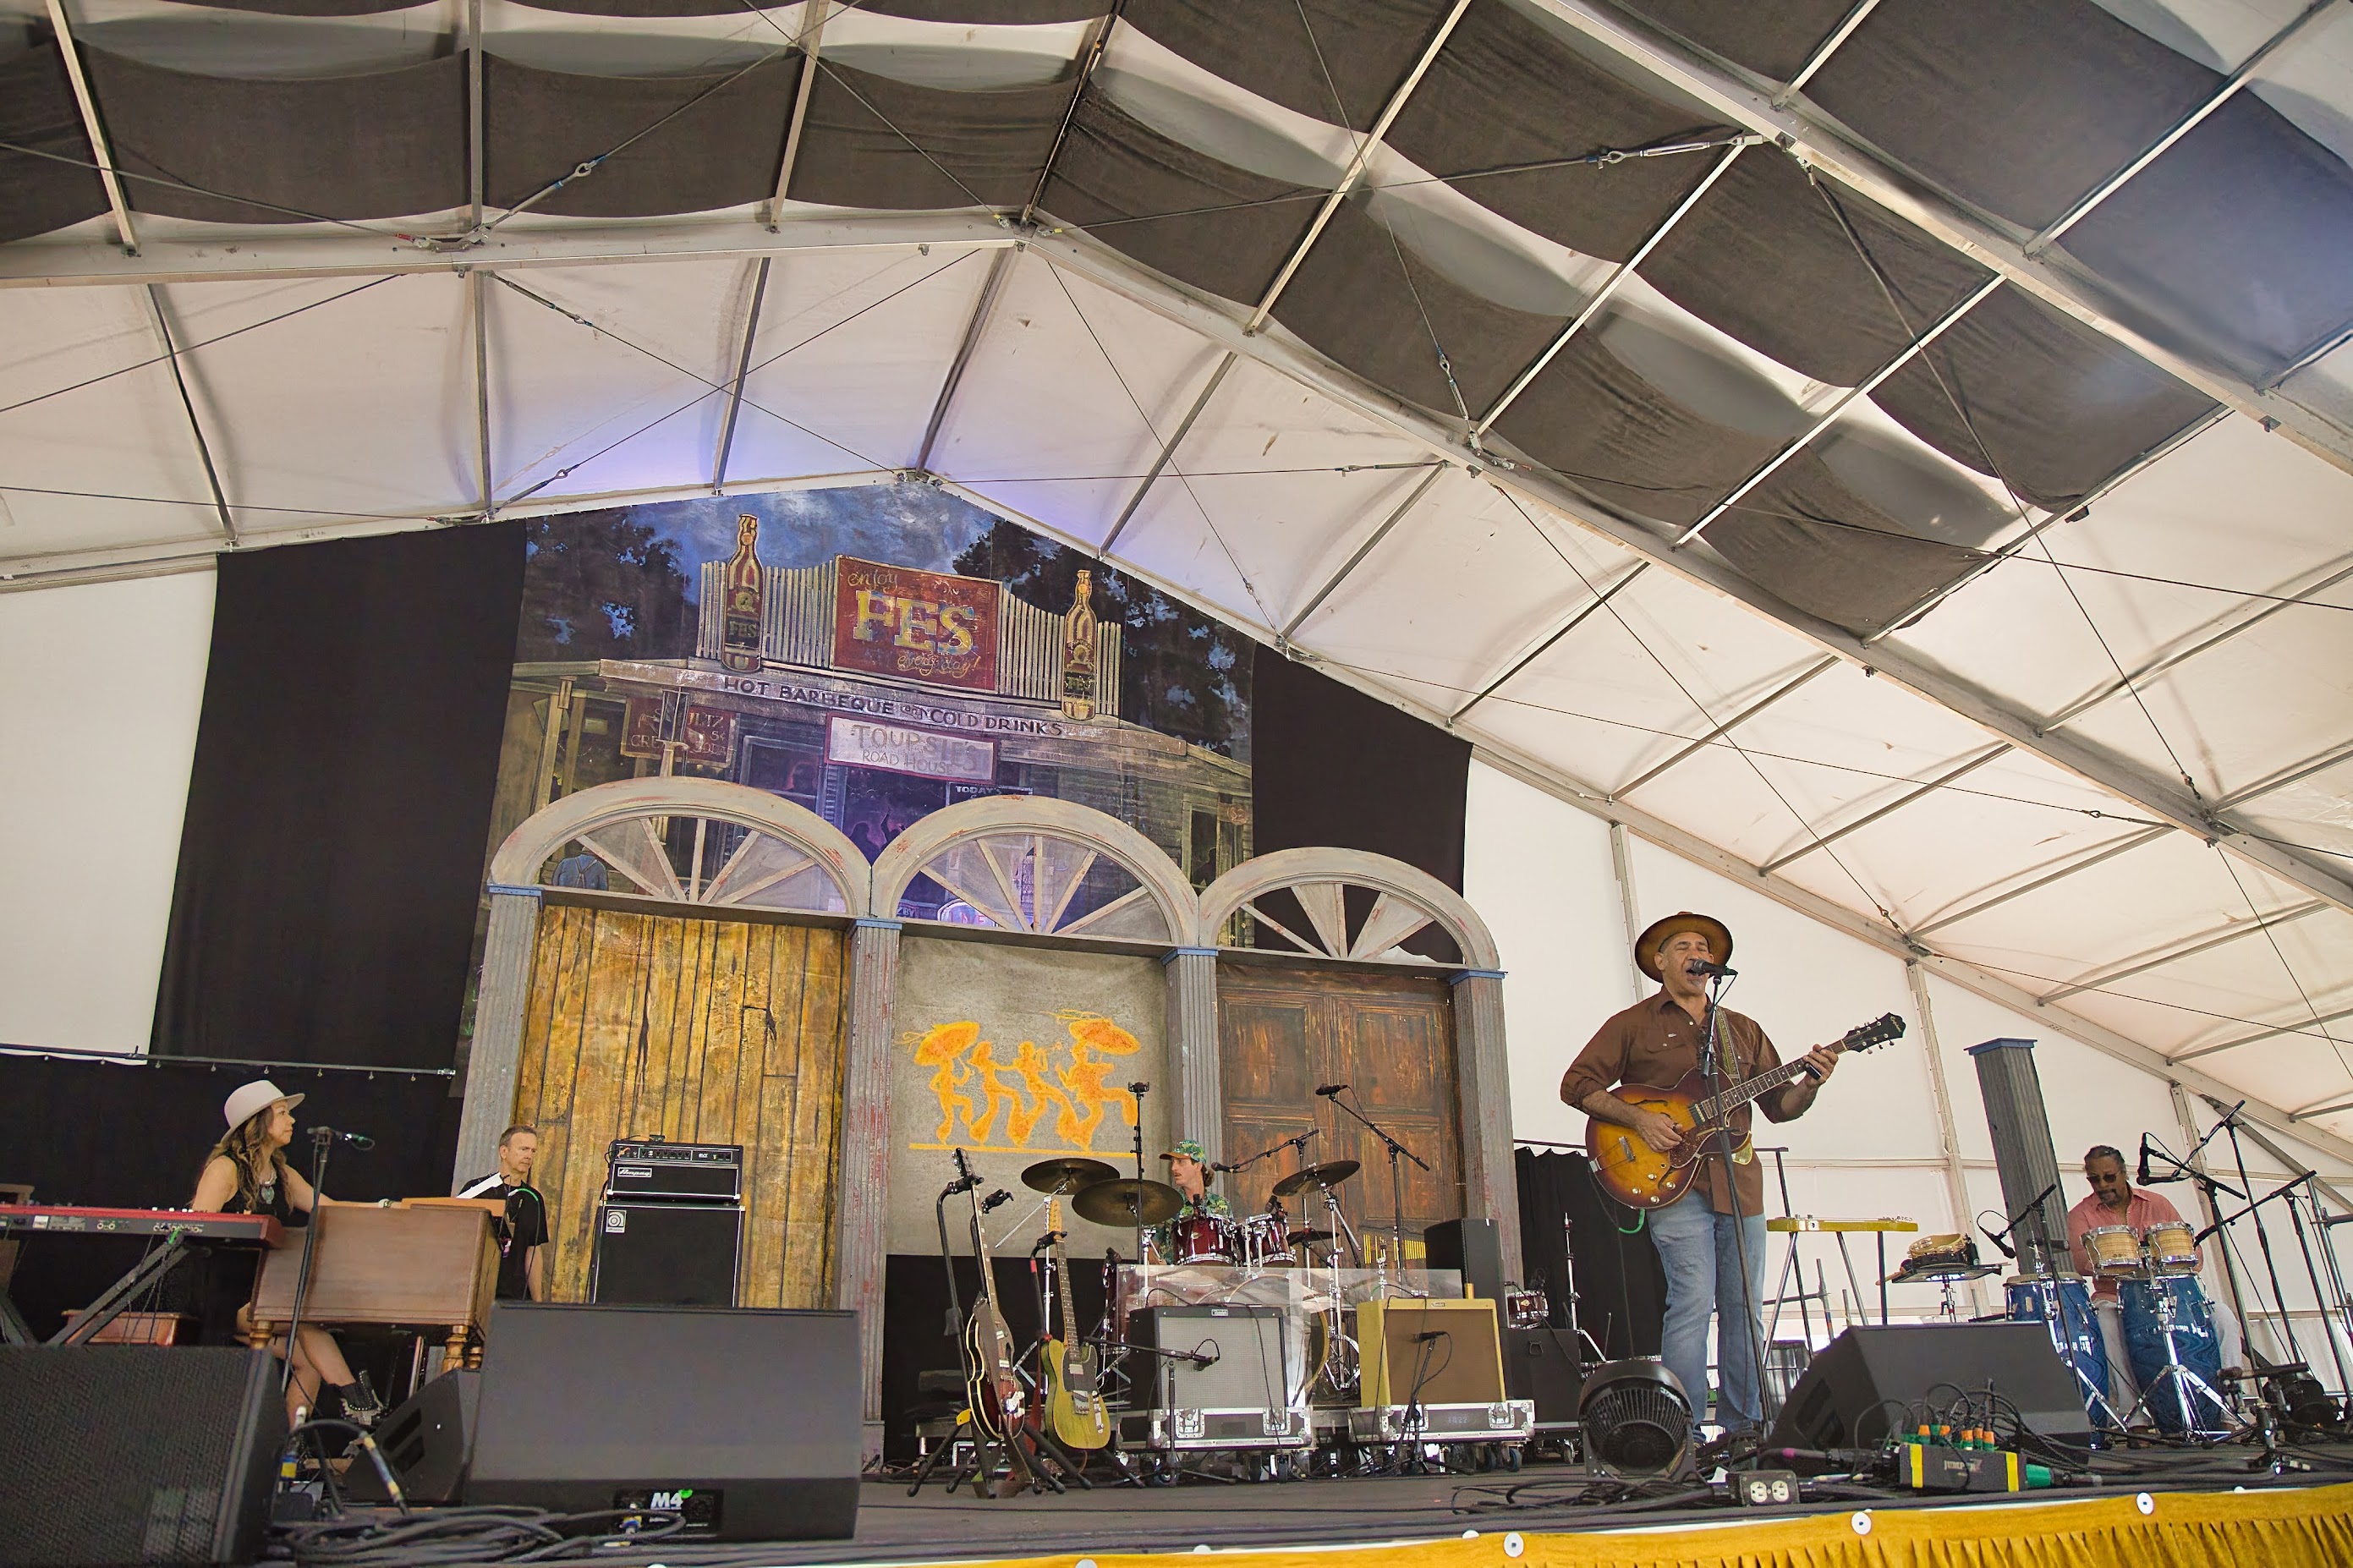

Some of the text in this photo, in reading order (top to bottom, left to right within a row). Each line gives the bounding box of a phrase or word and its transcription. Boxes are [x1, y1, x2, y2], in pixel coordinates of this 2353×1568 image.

[848, 570, 898, 593] enjoy
[853, 590, 974, 655] FES
[724, 677, 770, 695] HOT
[780, 686, 894, 715] BARBEQUE
[930, 708, 978, 727] COLD
[985, 715, 1062, 735] DRINKS
[863, 749, 952, 775] ROAD HOUSE
[955, 785, 1002, 794] TODAY'S
[651, 1492, 683, 1507] M4
